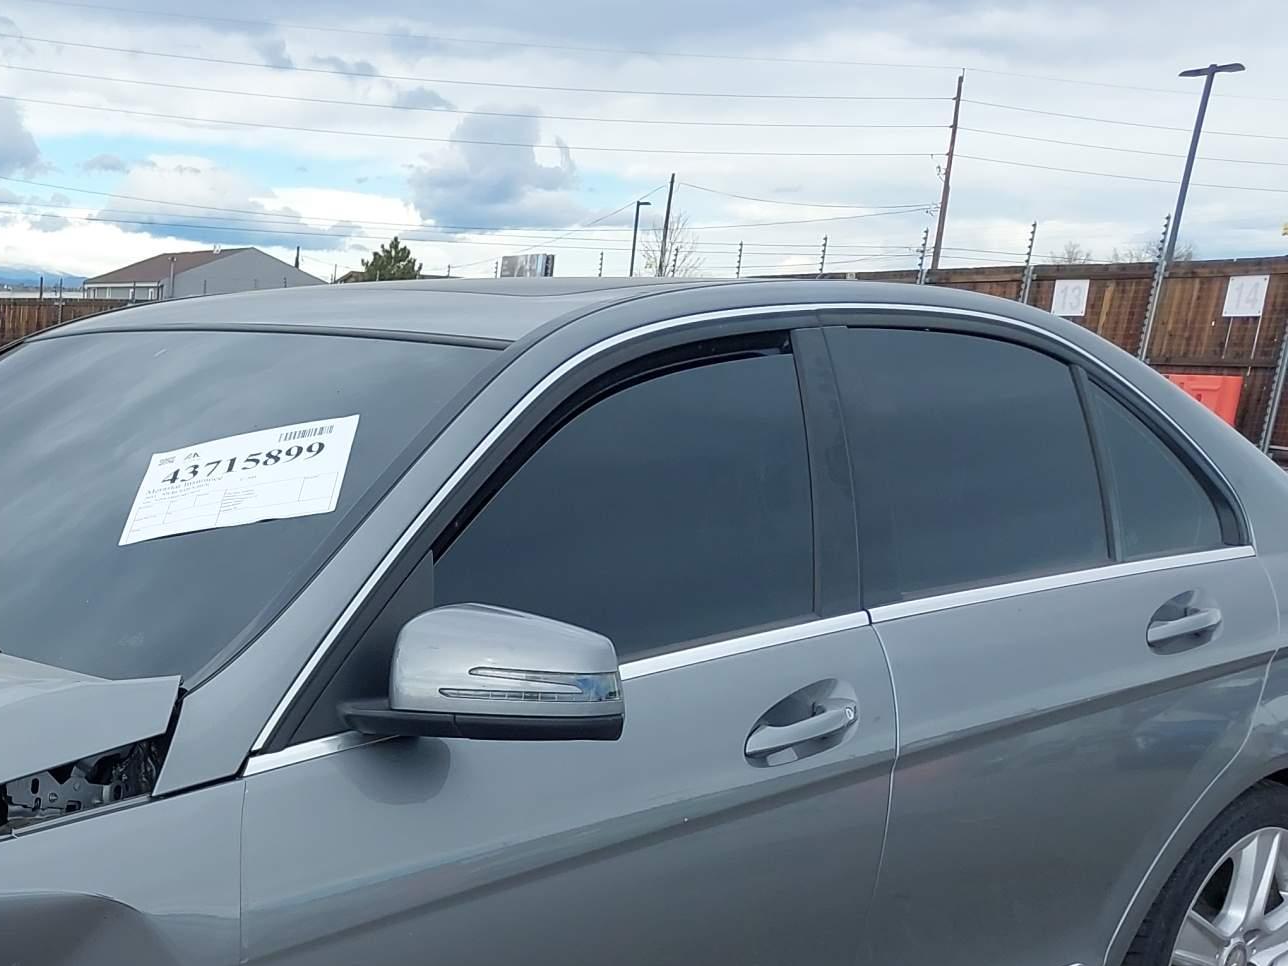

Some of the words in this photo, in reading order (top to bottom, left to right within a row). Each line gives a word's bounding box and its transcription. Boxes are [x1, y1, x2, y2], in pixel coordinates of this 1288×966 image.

[1060, 285, 1081, 311] 13
[1234, 281, 1260, 310] 14
[161, 441, 325, 484] 43715899
